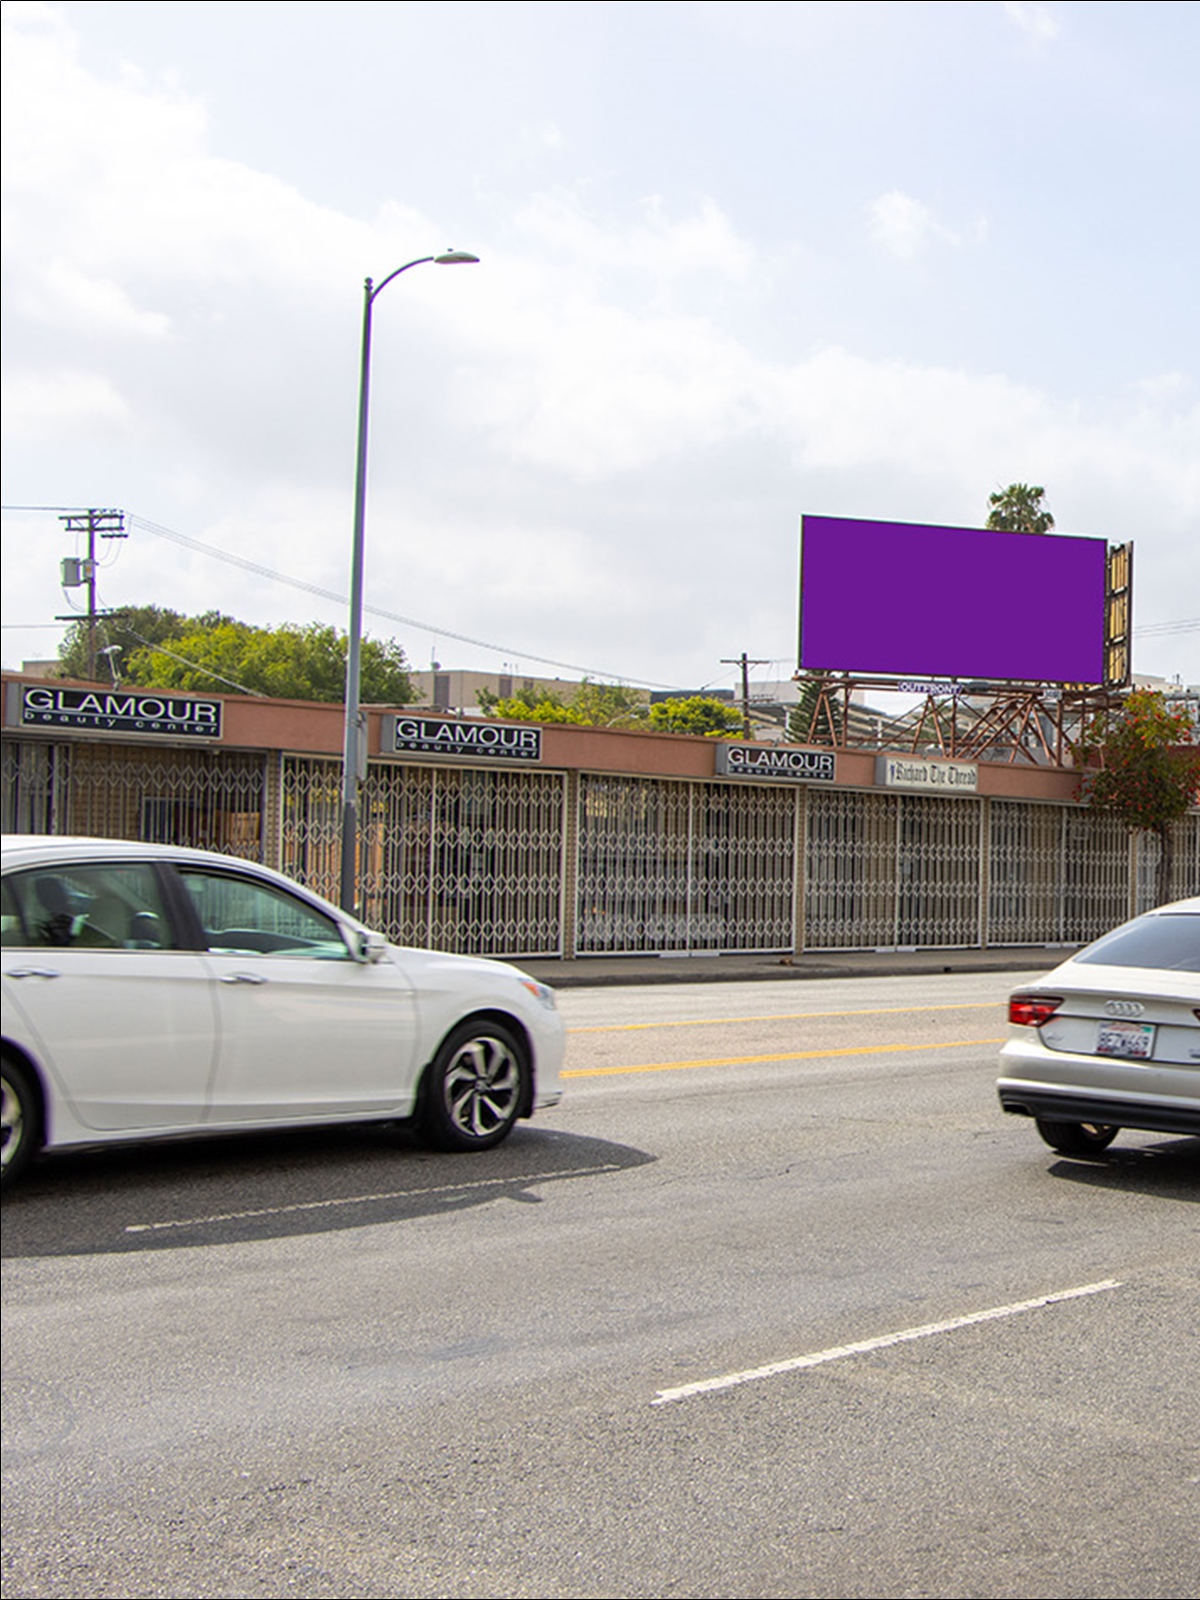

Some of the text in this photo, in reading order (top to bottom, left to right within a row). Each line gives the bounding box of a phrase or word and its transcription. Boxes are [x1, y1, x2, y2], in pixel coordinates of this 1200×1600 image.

[25, 688, 217, 723] GLAMOUR
[24, 711, 217, 734] beauty center
[397, 720, 537, 748] GLAMOUR
[396, 741, 537, 758] beauty center
[728, 748, 833, 771] GLAMOUR
